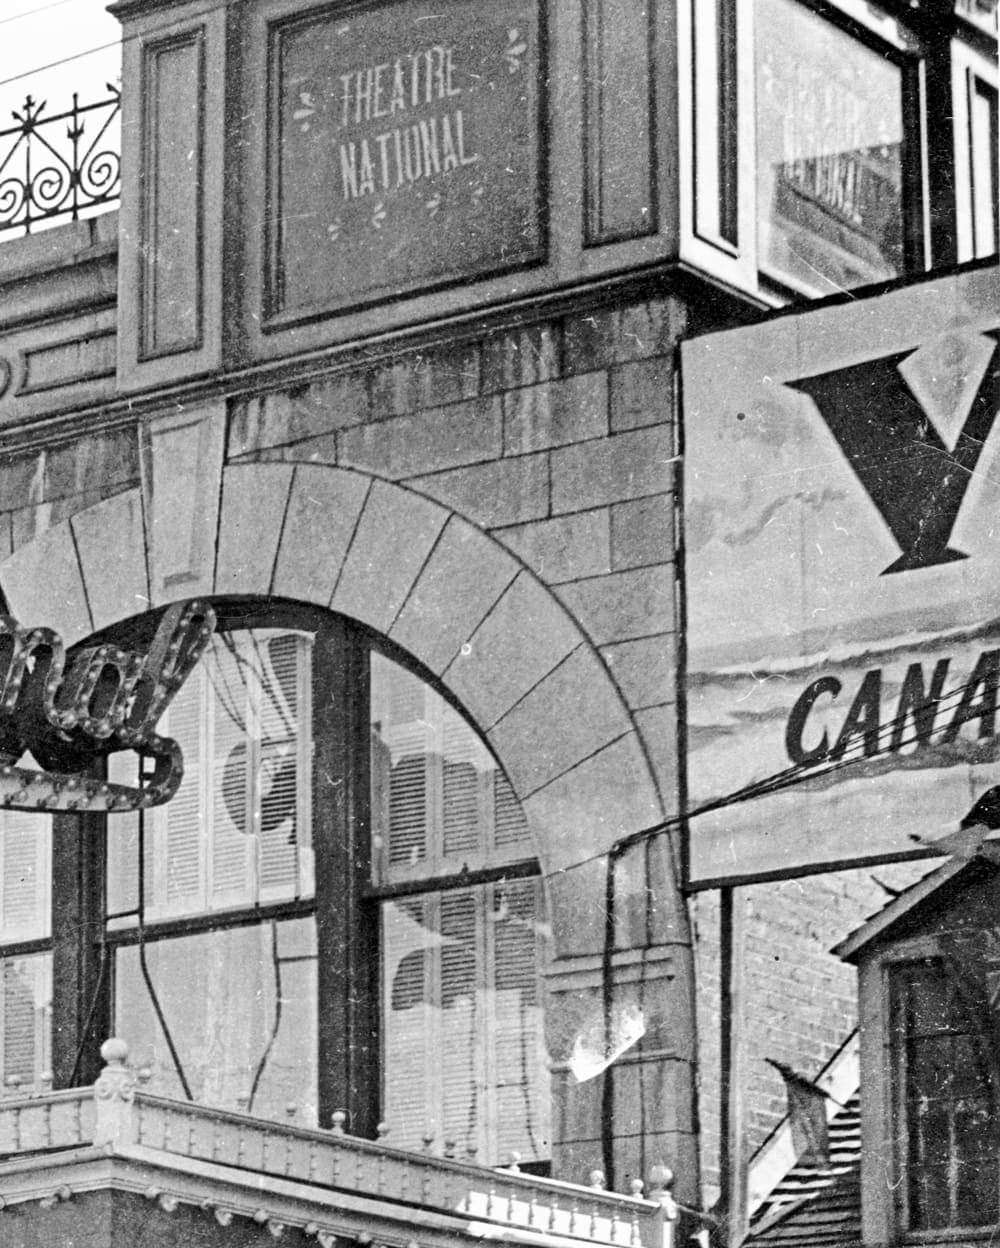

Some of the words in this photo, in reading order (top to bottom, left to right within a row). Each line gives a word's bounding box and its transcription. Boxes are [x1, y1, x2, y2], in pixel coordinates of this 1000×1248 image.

[340, 46, 461, 126] THEATRE
[340, 111, 478, 200] NATIONAL
[786, 651, 1000, 768] CANA
